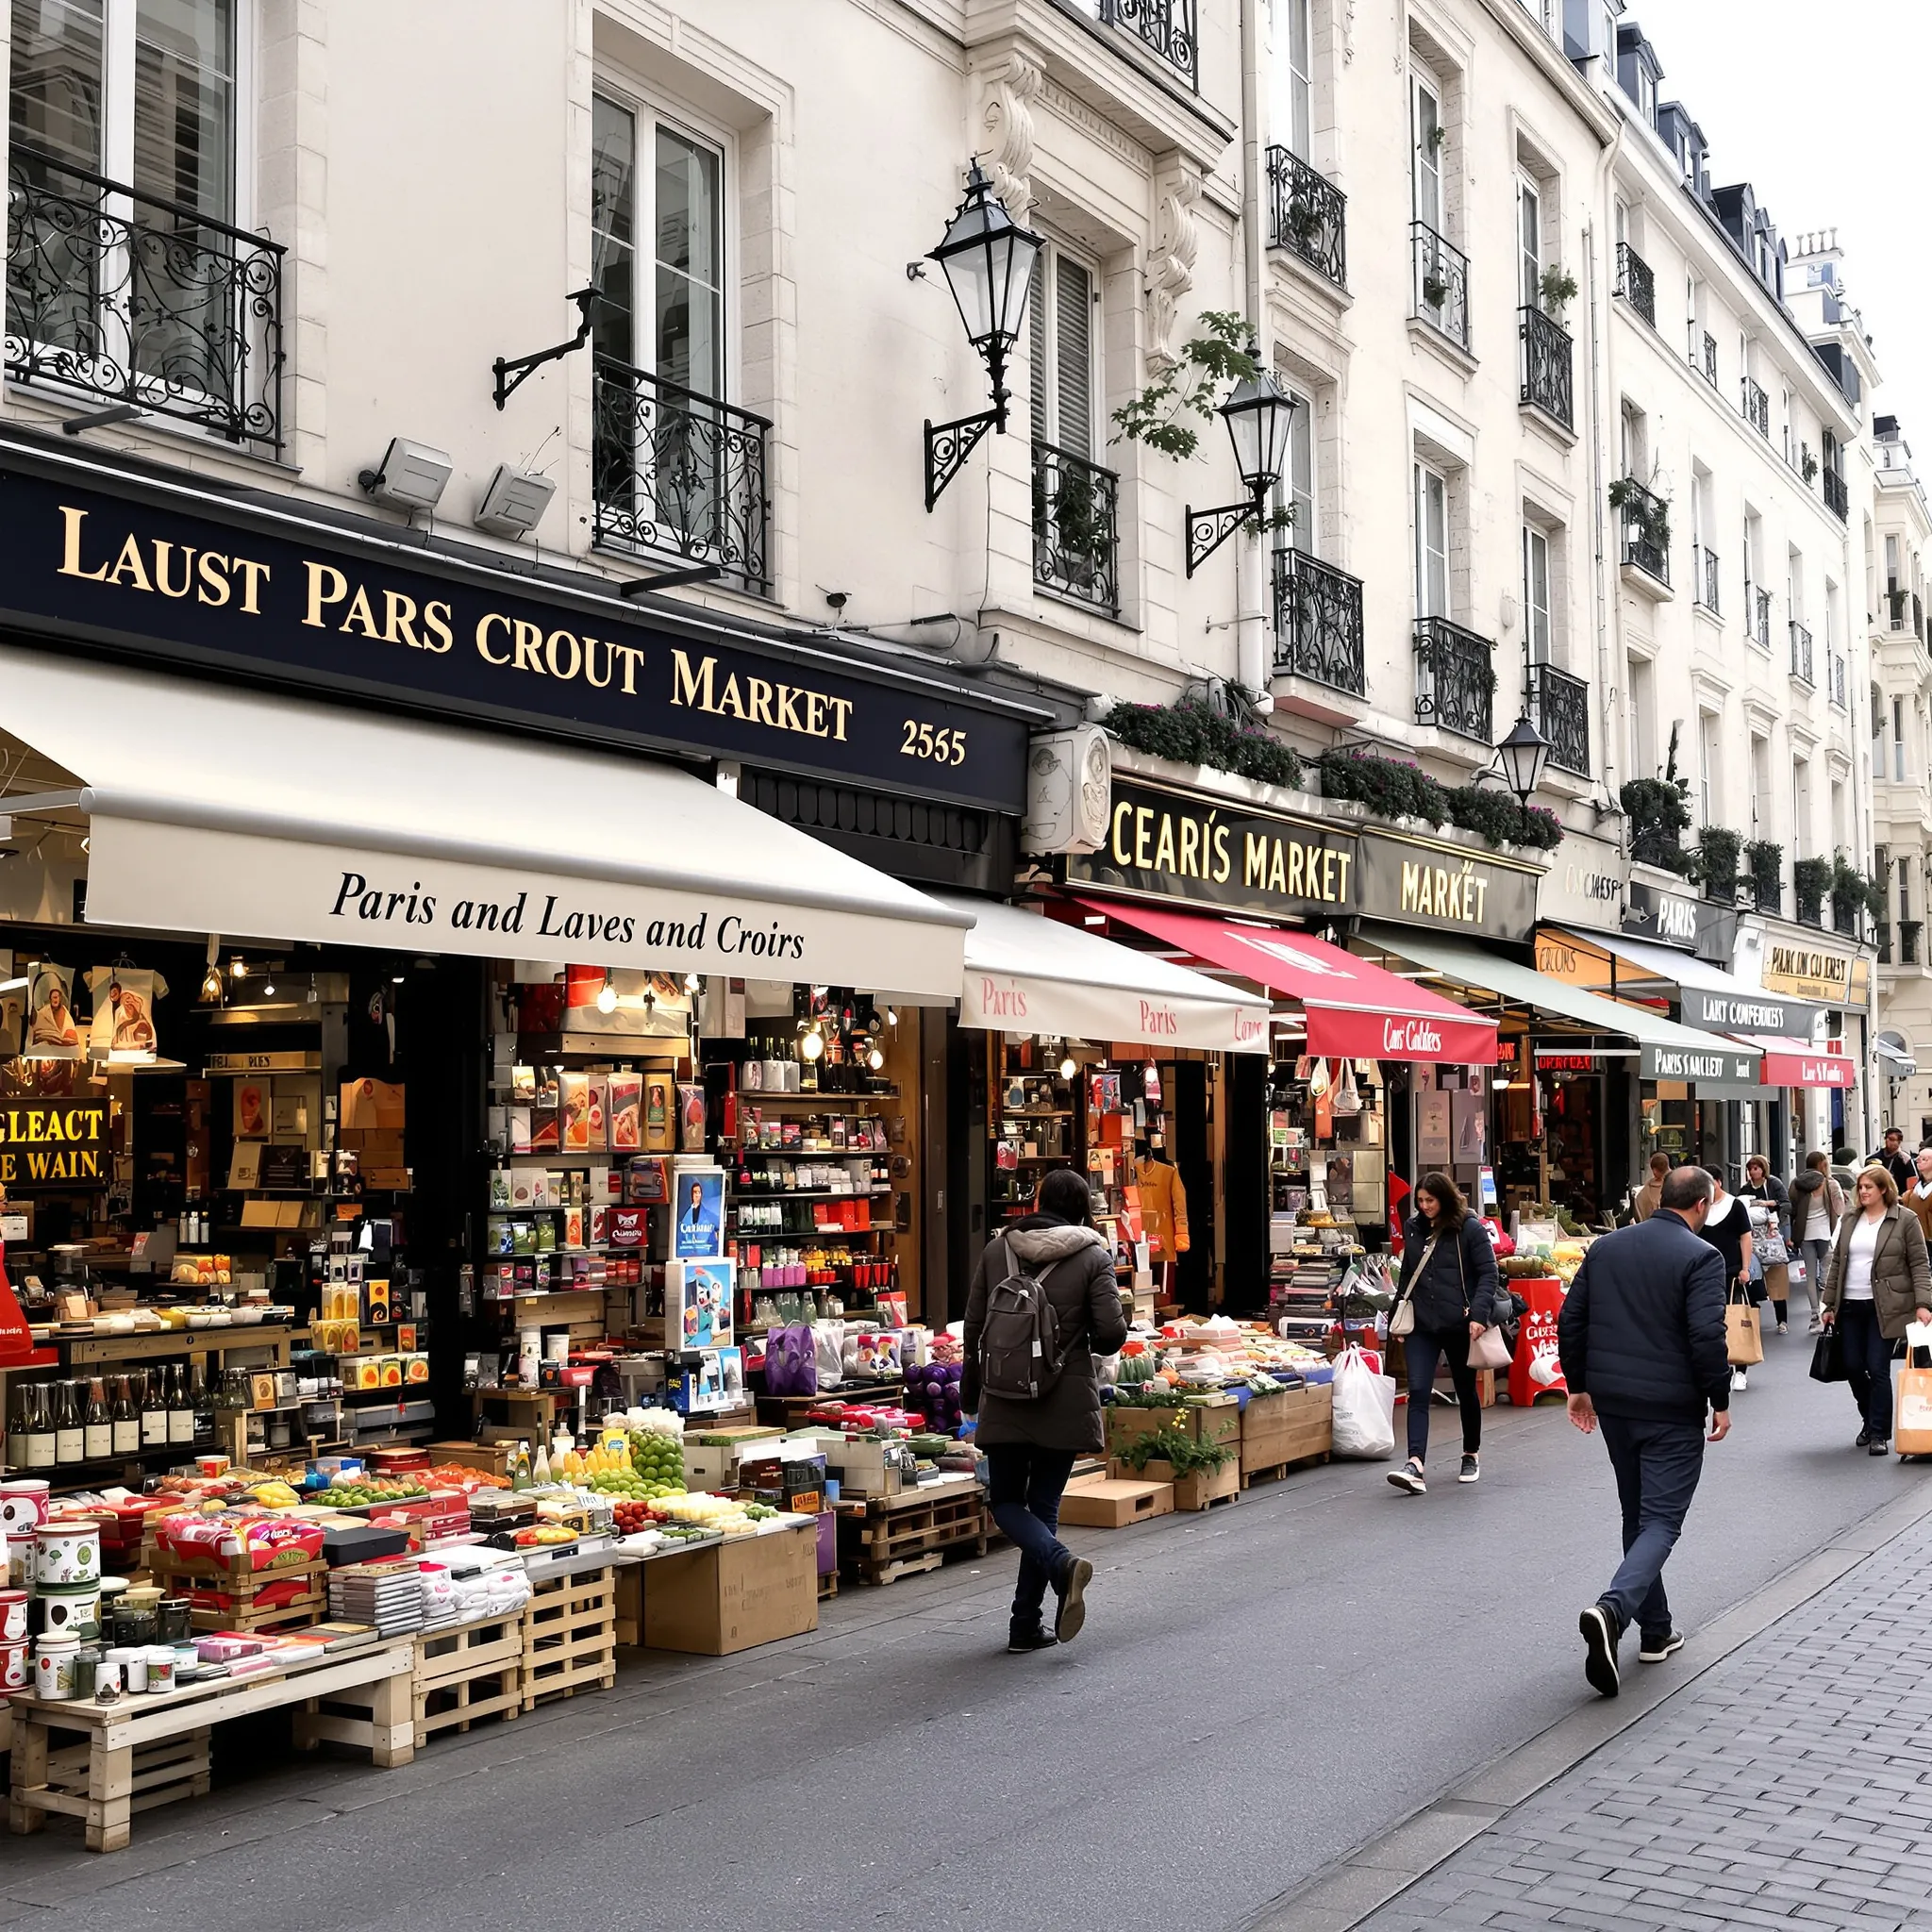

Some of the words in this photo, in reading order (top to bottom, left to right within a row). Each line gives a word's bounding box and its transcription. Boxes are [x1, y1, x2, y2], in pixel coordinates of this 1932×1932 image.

[57, 505, 271, 615] LAUST
[301, 560, 454, 654] PARS
[475, 612, 644, 695] CROUT
[669, 648, 853, 742] MARKET
[900, 719, 967, 766] 2565
[1243, 832, 1352, 904] MARKET
[329, 871, 437, 924] Paris
[451, 892, 527, 935] and
[536, 894, 635, 943] Laves
[646, 912, 708, 950] and
[717, 915, 805, 960] Croirs
[1657, 897, 1697, 940] PARIS
[1140, 1000, 1178, 1036] Paris
[0, 1109, 103, 1143] LEACT
